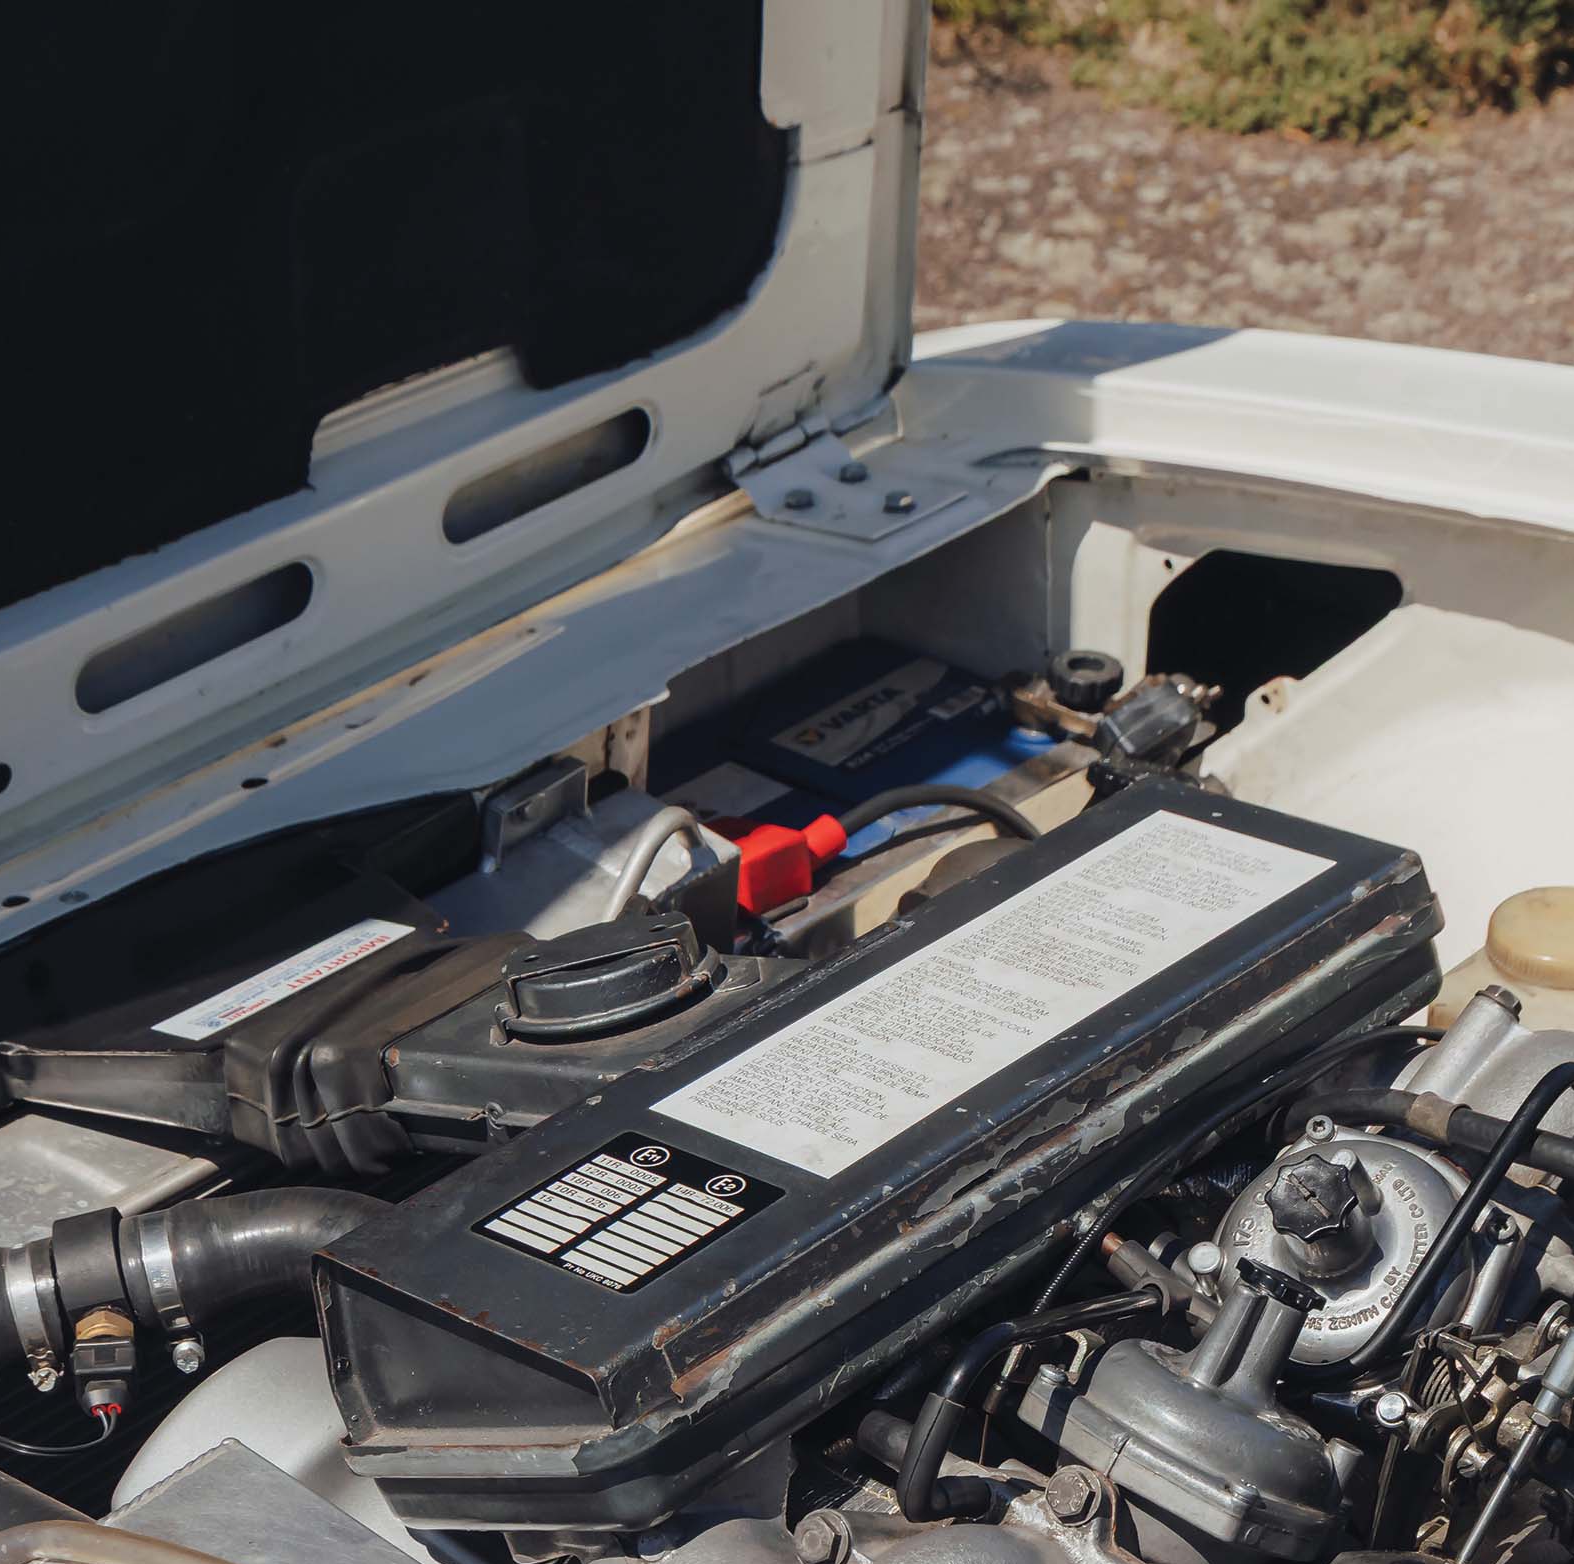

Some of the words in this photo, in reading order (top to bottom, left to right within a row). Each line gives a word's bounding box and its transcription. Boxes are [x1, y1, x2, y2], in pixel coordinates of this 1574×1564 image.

[287, 935, 391, 990] IMPORTANT
[1327, 1304, 1380, 1331] ZENITH
[1392, 1177, 1417, 1202] LTD
[1383, 1265, 1402, 1287] BY
